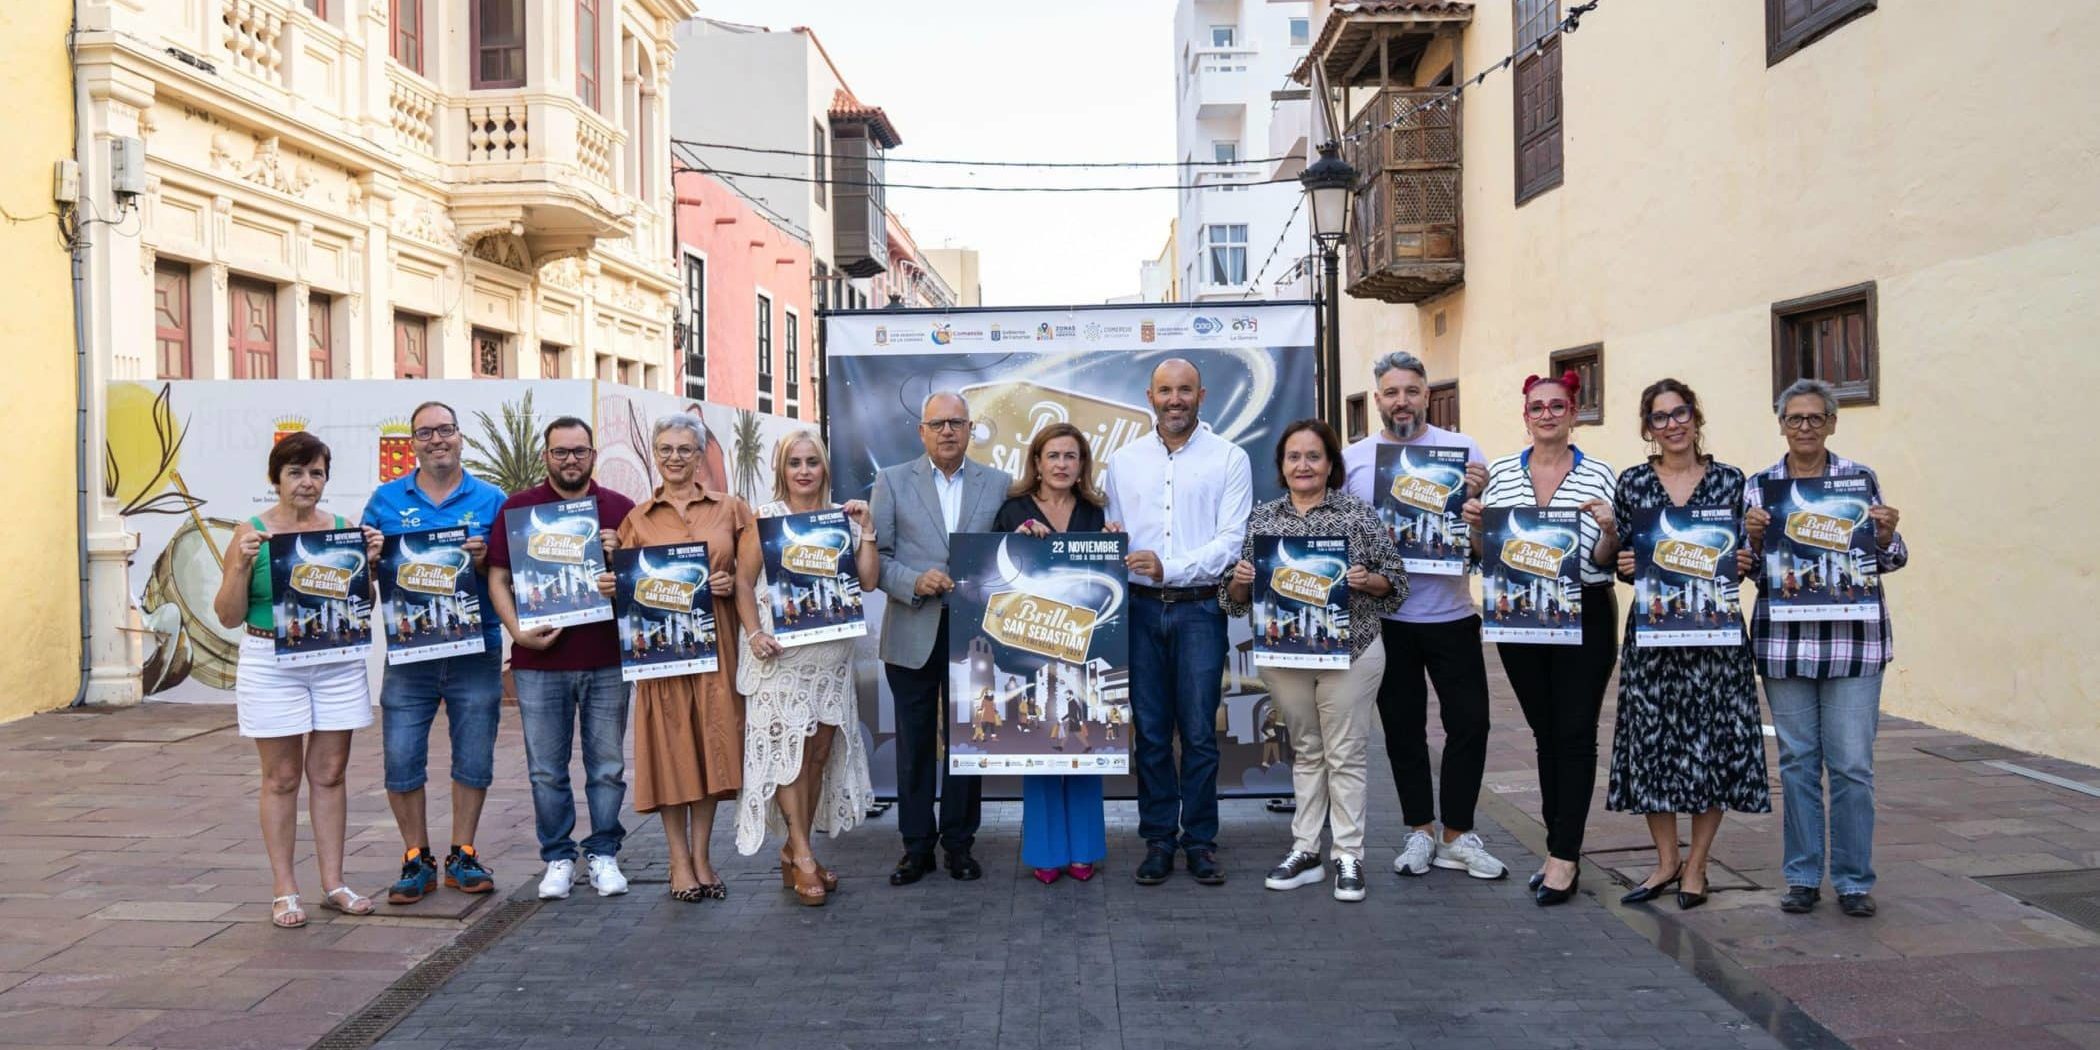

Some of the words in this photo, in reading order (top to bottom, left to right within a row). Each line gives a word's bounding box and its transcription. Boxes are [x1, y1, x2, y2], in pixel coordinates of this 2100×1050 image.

[1052, 541, 1064, 553] 22
[1068, 540, 1120, 553] NOVIEMBRE
[1003, 617, 1026, 636] SAN
[1014, 600, 1078, 634] Brilla
